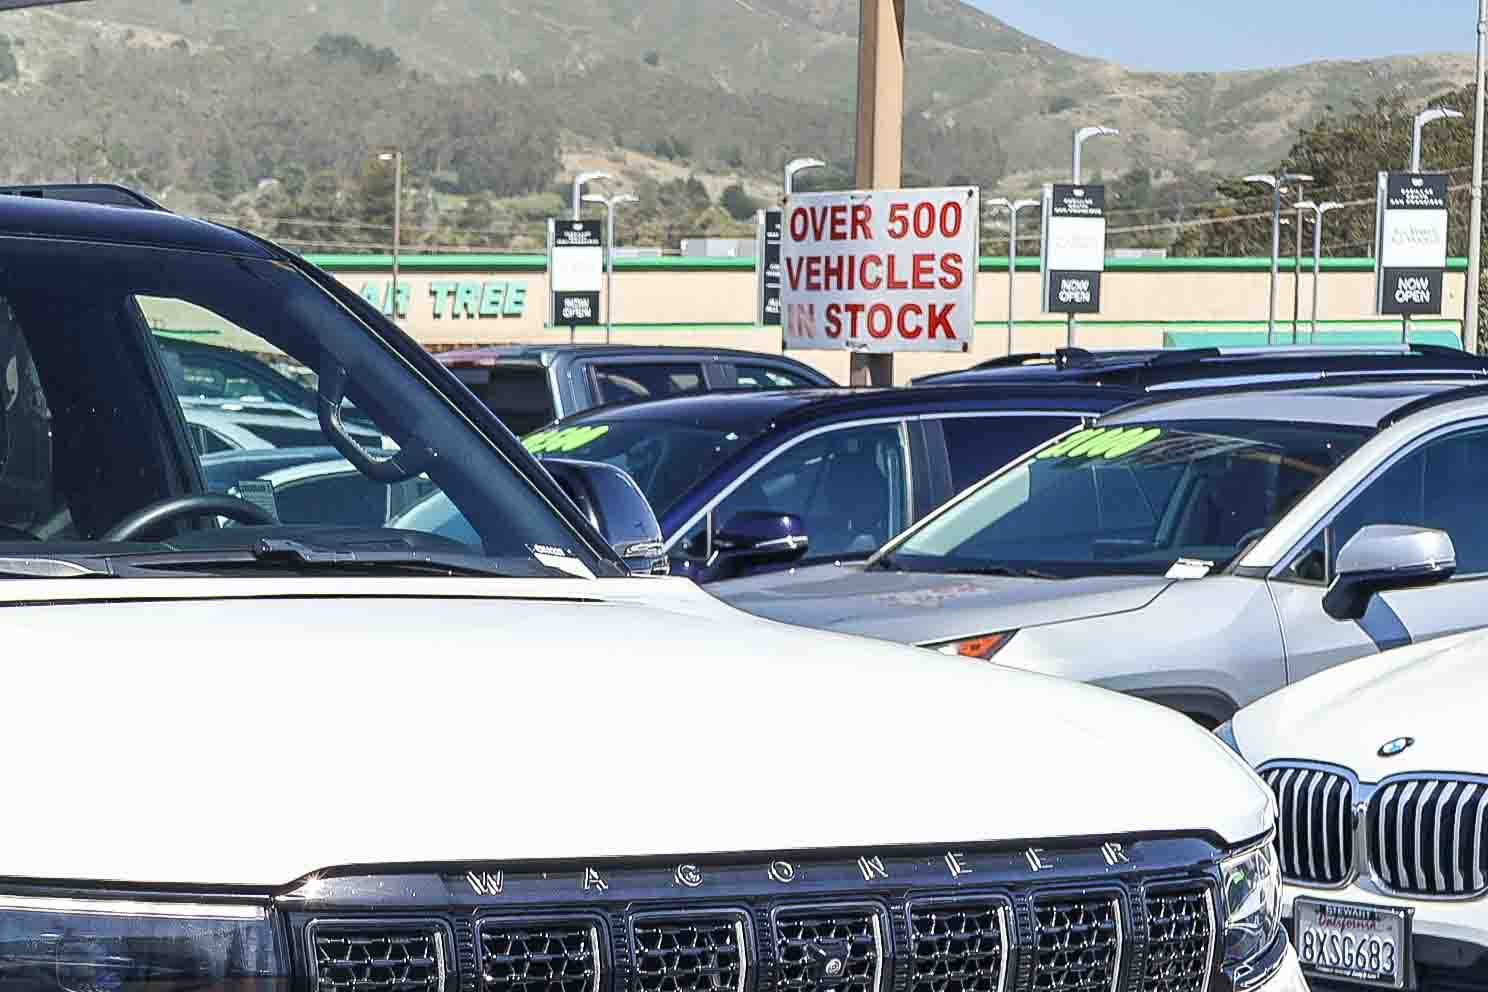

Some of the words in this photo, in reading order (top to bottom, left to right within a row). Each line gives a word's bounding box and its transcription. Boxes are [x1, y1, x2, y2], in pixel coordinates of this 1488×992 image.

[790, 204, 873, 241] OVER
[887, 201, 962, 240] 500
[786, 253, 963, 290] VEHICLES
[1059, 279, 1090, 291] NOW
[1397, 277, 1429, 290] NOW
[429, 280, 528, 319] TREE
[1058, 290, 1091, 303] OPEN
[1394, 289, 1431, 304] OPEN
[788, 303, 816, 337] IN
[824, 303, 957, 340] STOCK
[465, 841, 1129, 896] WAGONEER
[1303, 930, 1395, 973] 8XSG683
